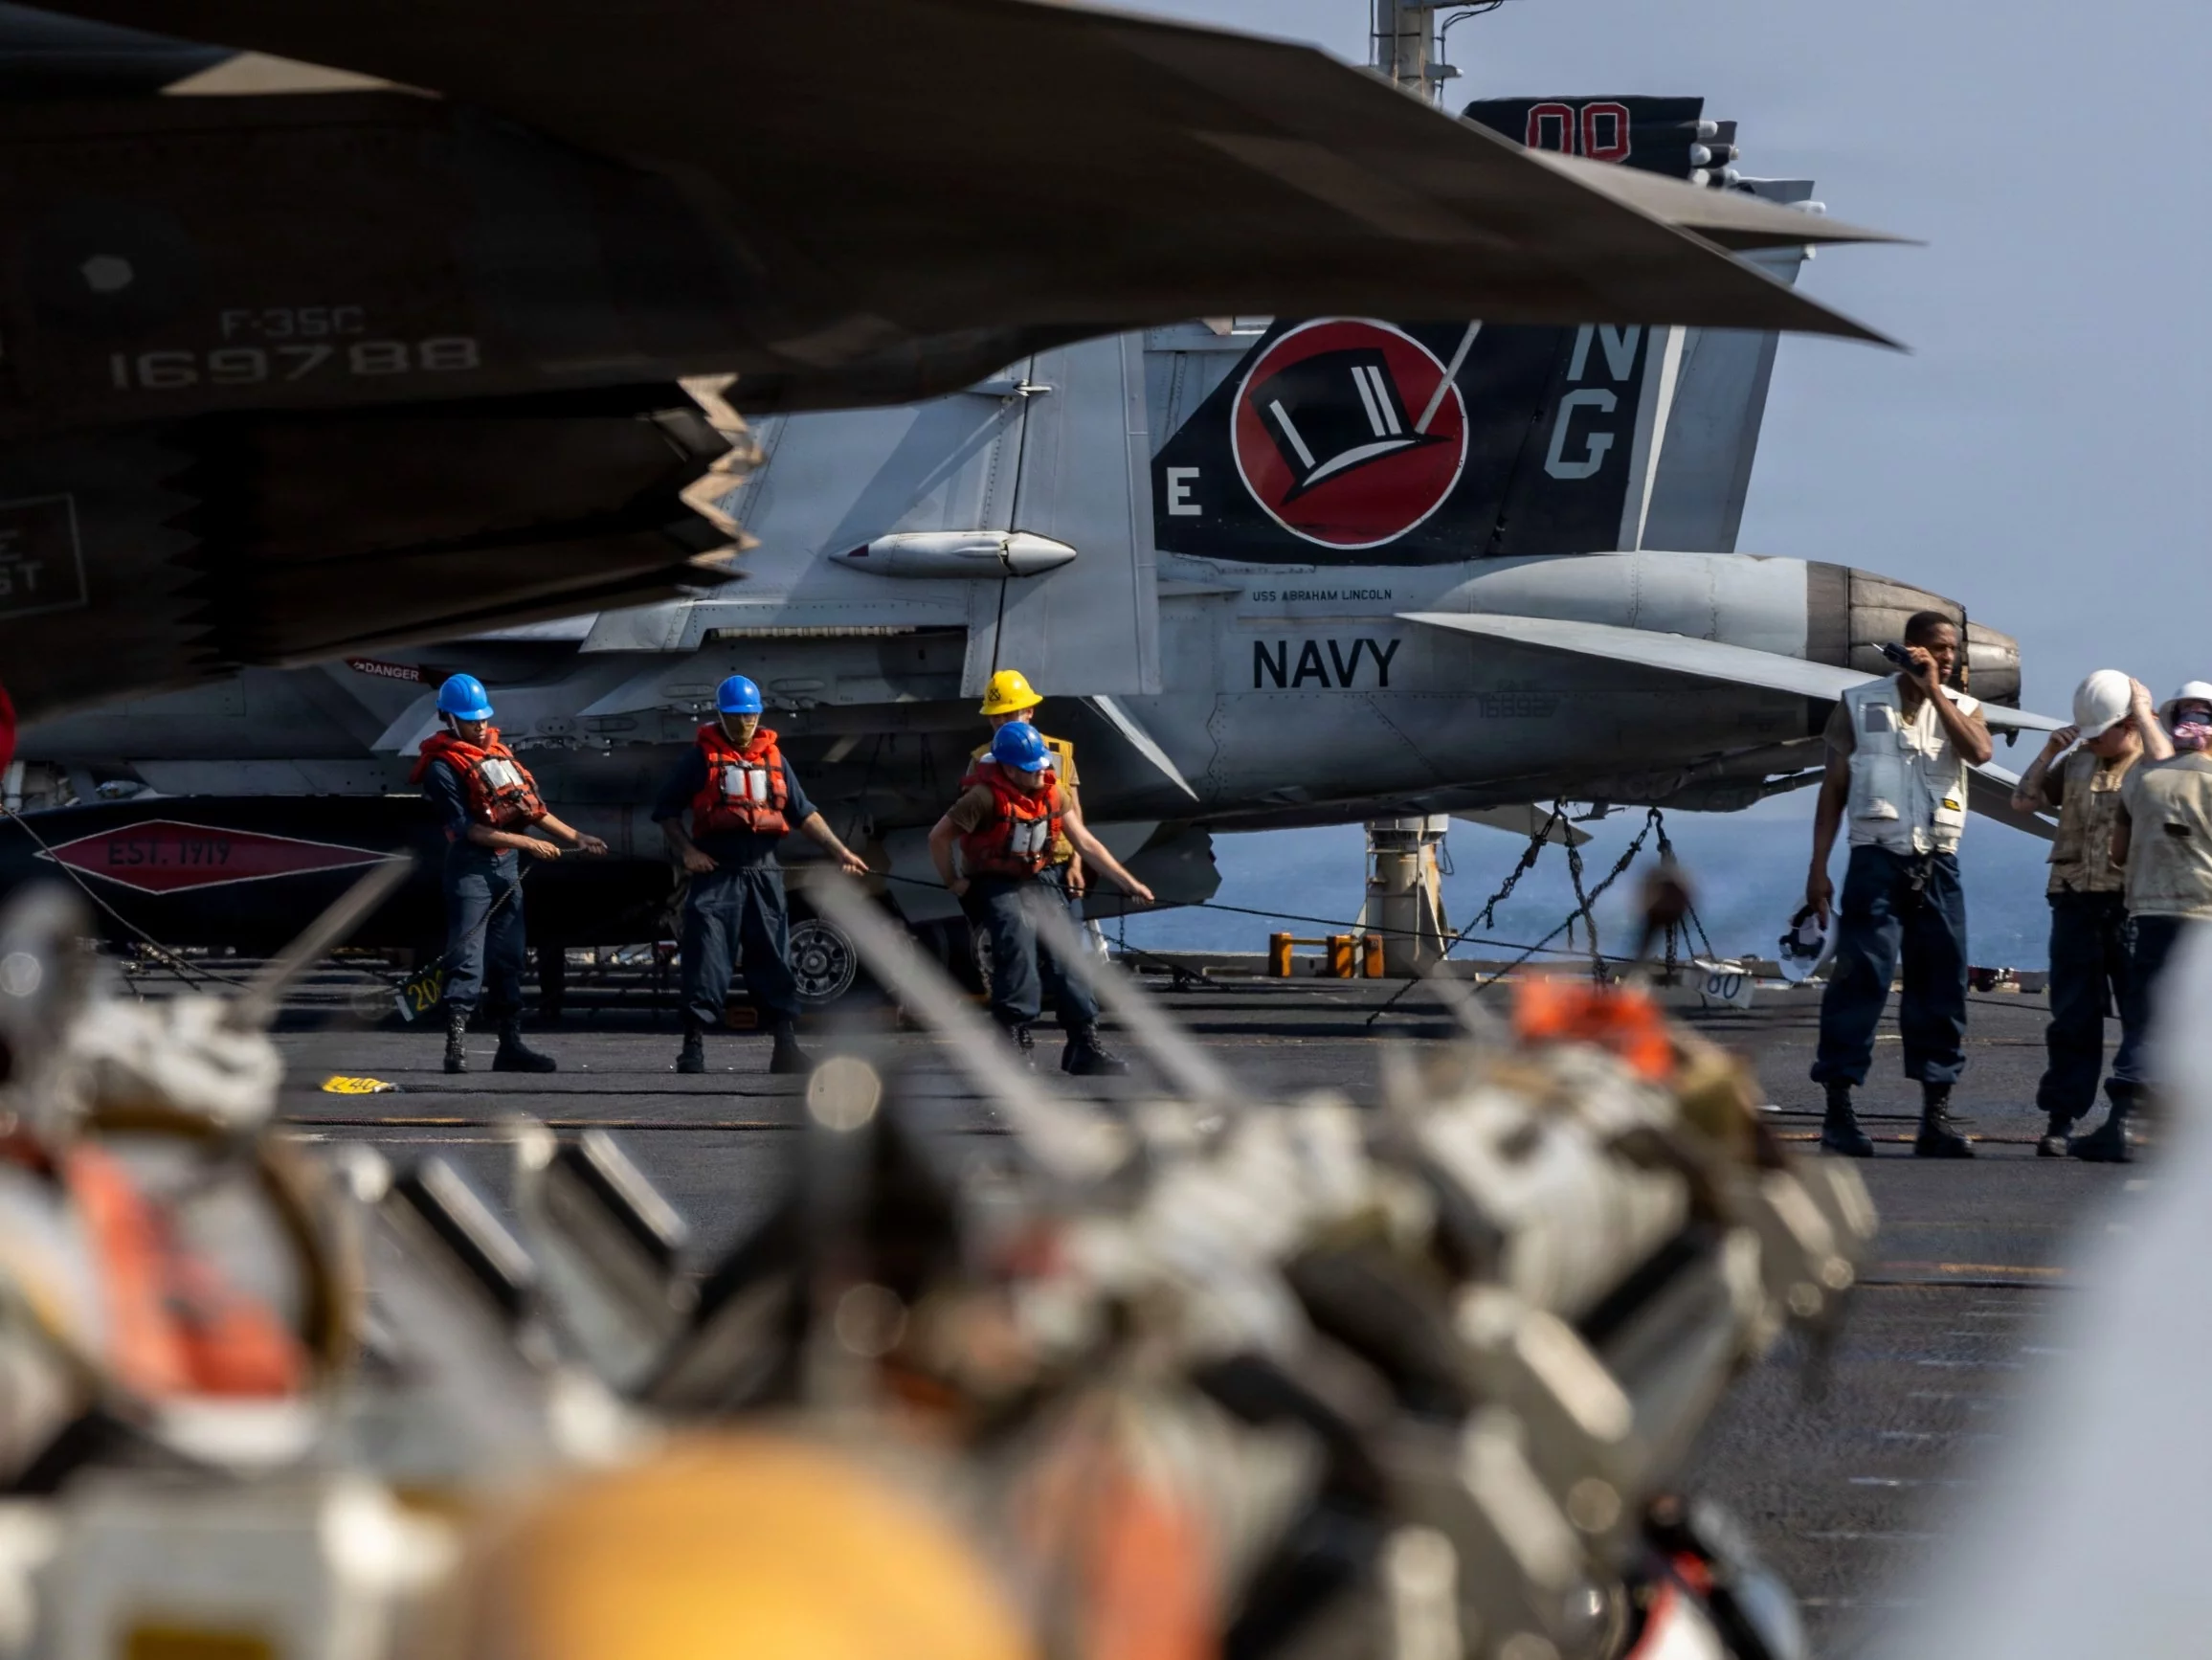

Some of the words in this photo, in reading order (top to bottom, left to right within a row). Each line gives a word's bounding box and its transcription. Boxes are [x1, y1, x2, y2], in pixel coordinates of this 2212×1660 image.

[109, 335, 480, 393] 169788
[1167, 466, 1203, 516] E
[1253, 591, 1277, 602] USS
[1281, 590, 1338, 601] ABRAHAM
[1341, 589, 1393, 601] LINCOLN
[366, 662, 420, 682] DANGER
[1253, 638, 1402, 689] NAVY
